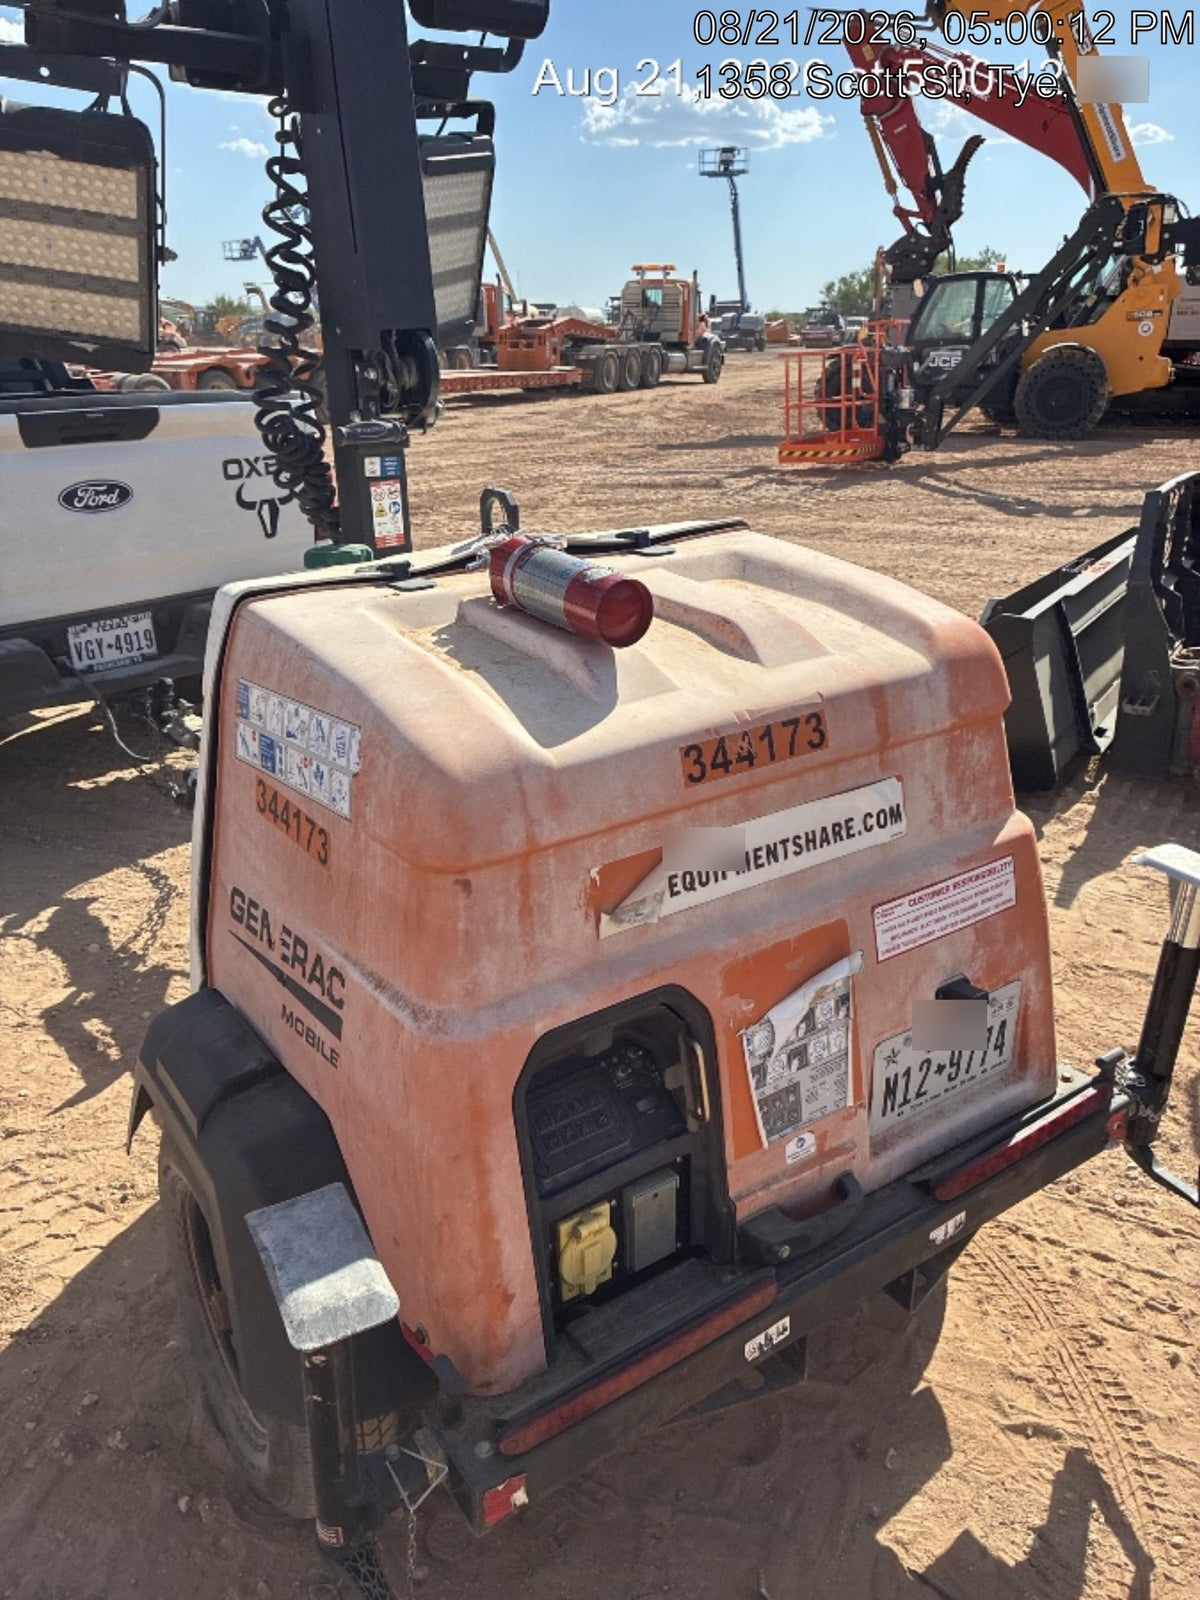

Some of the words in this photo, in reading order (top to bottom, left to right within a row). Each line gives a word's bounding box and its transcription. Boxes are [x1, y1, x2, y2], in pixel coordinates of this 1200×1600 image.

[73, 485, 120, 508] Ford
[683, 712, 826, 783] 344173
[256, 779, 328, 865] 344173
[230, 886, 346, 1010] GENERAC
[281, 1003, 340, 1070] MOBILE
